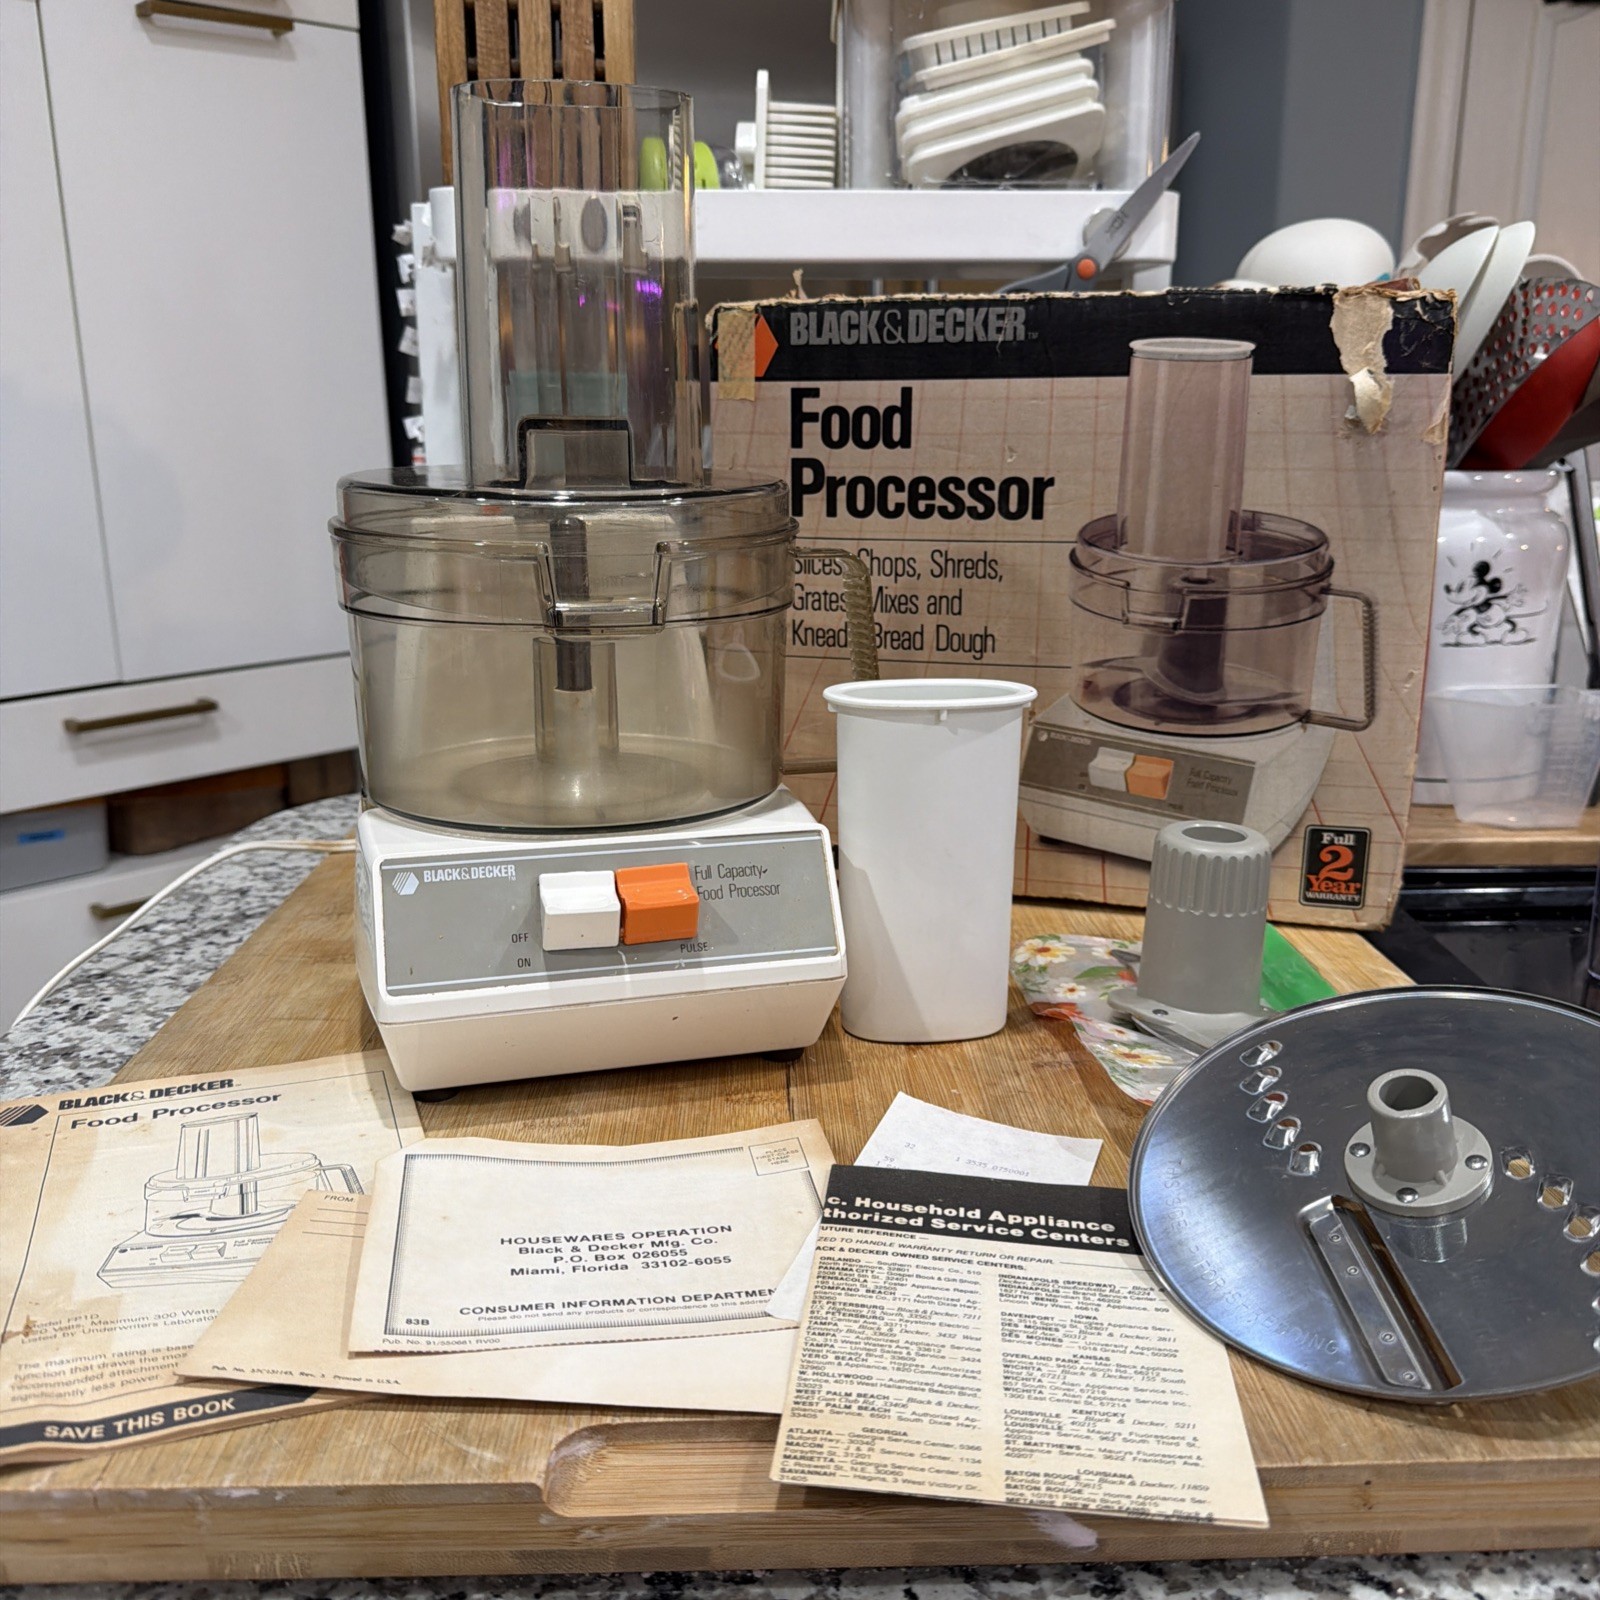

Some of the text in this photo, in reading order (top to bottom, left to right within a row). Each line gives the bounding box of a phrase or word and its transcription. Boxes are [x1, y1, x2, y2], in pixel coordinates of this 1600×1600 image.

[790, 306, 1026, 346] BLACK&DECKER
[791, 387, 913, 450] Food
[791, 458, 1055, 520] Processor
[930, 549, 1003, 582] Shreds,
[927, 588, 962, 616] and
[792, 619, 996, 660] Knead Bread Dough
[1321, 832, 1356, 846] Full
[1319, 845, 1354, 881] 2
[424, 864, 516, 883] BLACK&DECKER
[694, 863, 764, 881] Full Capacity
[1306, 874, 1361, 895] Year
[697, 883, 780, 901] Food Processor
[1305, 891, 1361, 903] WARRANTY
[511, 933, 529, 944] OFF
[680, 942, 708, 953] PULSE
[517, 958, 531, 968] ON
[71, 1094, 283, 1130] Food Processor
[827, 1196, 1116, 1233] c. Household Appliance
[820, 1225, 916, 1240] UTURE REFERENCE
[823, 1207, 1130, 1248] thorized Service Centers
[500, 1225, 733, 1245] HOUSEWARES OPERATION
[518, 1236, 718, 1255] Black & Decker Mfg. Co.
[855, 1239, 895, 1248] HANDLE
[898, 1243, 953, 1254] WARRANTY
[956, 1249, 997, 1258] RETURN
[553, 1248, 688, 1264] P.O. Box 026055
[819, 1256, 861, 1264] ORLANDO
[848, 1247, 889, 1256] DECKER
[891, 1252, 930, 1260] OWNED
[931, 1255, 974, 1265] SERVICE
[976, 1261, 1027, 1271] CENTERS.
[510, 1255, 732, 1277] Miami, Florida 33102-6055
[818, 1265, 854, 1273] PANAMA
[816, 1275, 868, 1284] PENSACOLA
[814, 1284, 860, 1293] POMPANO
[459, 1302, 555, 1315] CONSUMER
[562, 1295, 676, 1309] INFORMATION
[478, 1314, 507, 1322] Please
[586, 1307, 624, 1316] products
[639, 1303, 707, 1312] correspondence
[1000, 1311, 1055, 1322] DAVENPORT
[1074, 1313, 1099, 1321] IOWA
[405, 1318, 430, 1326] 83B
[1024, 1324, 1060, 1333] MOINES
[834, 1355, 868, 1363] BEACH
[1002, 1352, 1053, 1362] OVERLAND
[1072, 1354, 1111, 1362] KANSAS
[1002, 1364, 1043, 1372] WICHITA
[812, 1371, 874, 1381] HOLLYWOOD
[825, 1389, 853, 1397] PALM
[856, 1393, 890, 1401] BEACH
[44, 1397, 236, 1440] SAVE THIS BOOK
[1004, 1408, 1062, 1419] LOUISVILLE
[1072, 1407, 1126, 1418] KENTUCKY
[787, 1427, 833, 1436] ATLANTA
[861, 1426, 908, 1437] GEORGIA
[785, 1441, 824, 1449] MACON
[782, 1454, 836, 1463] MARIETTA
[780, 1467, 837, 1477] SAVANNAH
[1077, 1468, 1134, 1480] LOUISIANA
